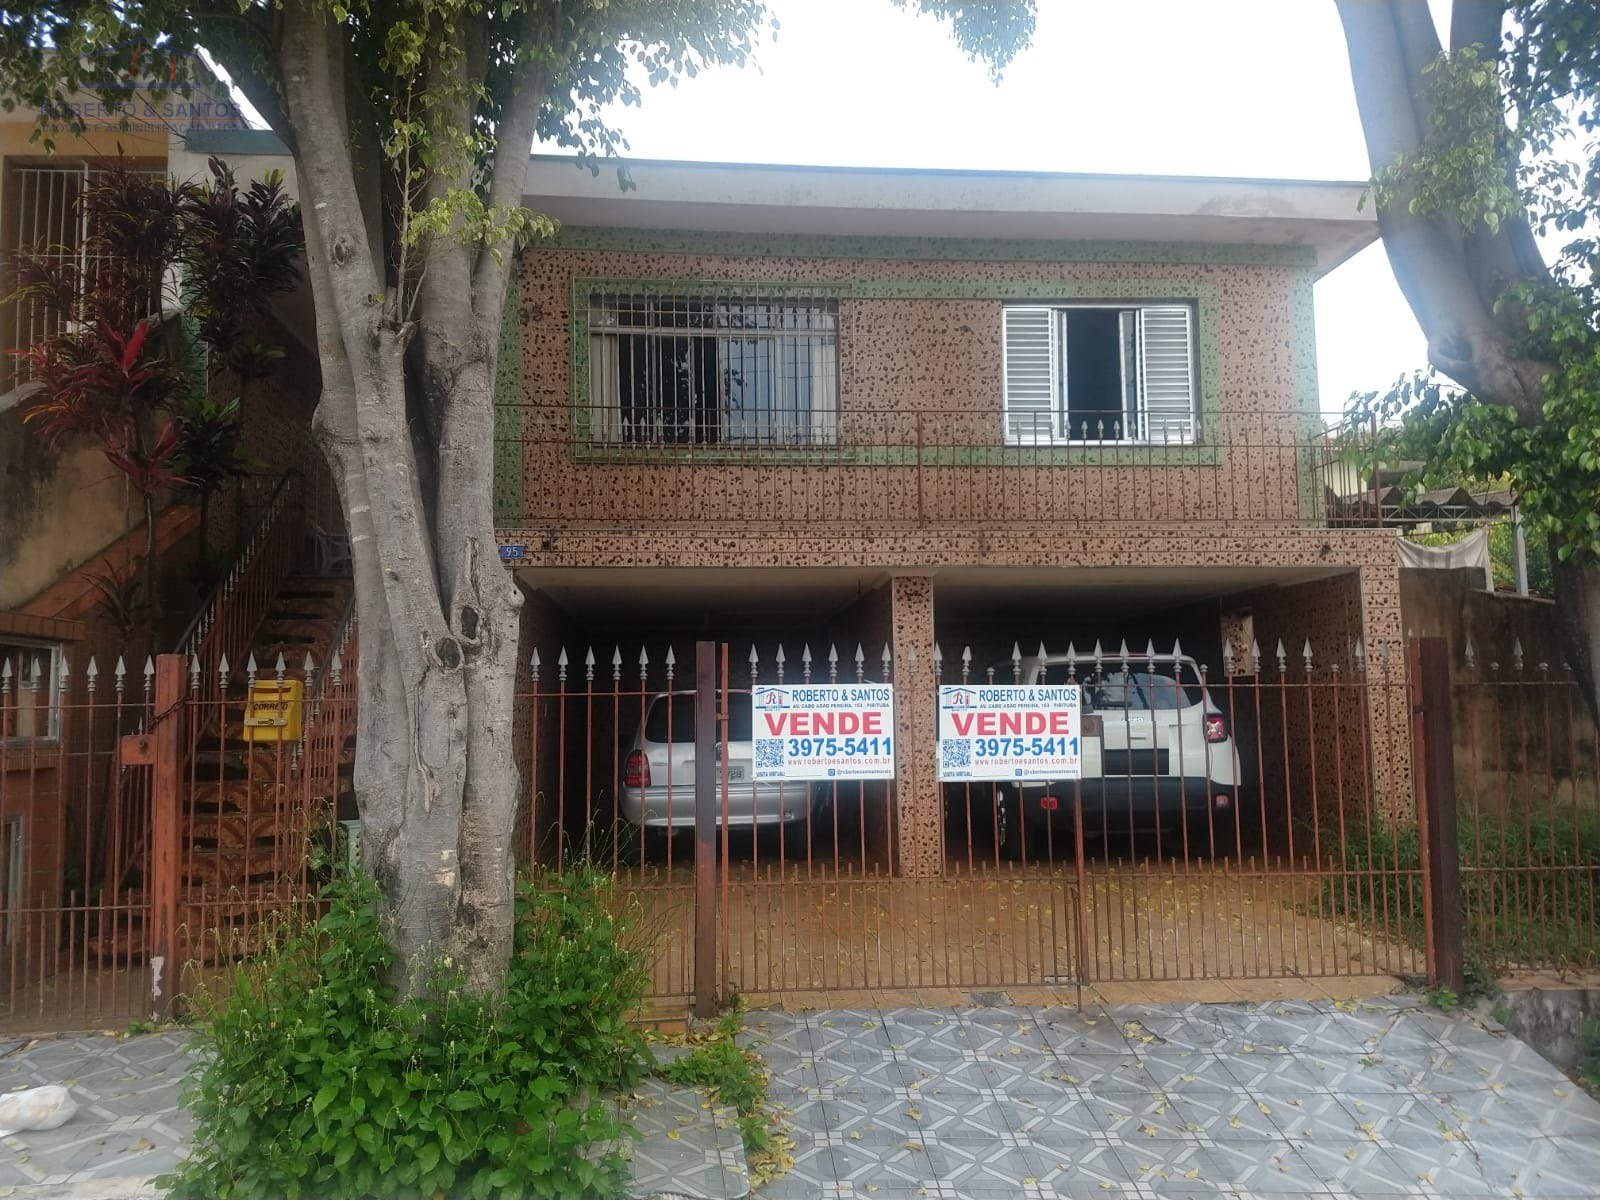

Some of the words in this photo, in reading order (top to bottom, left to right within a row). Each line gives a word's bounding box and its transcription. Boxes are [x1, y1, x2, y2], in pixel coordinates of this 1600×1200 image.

[506, 546, 519, 557] 95
[792, 689, 839, 702] ROBERTO
[841, 689, 848, 701] &
[851, 688, 890, 701] SANTOS
[979, 689, 1026, 702] ROBERTO
[1028, 689, 1035, 701] &
[1038, 688, 1077, 701] SANTOS
[254, 702, 289, 711] CORREO
[764, 712, 882, 736] VENDE
[951, 712, 1069, 736] VENDE
[788, 737, 891, 757] 3975-5411
[975, 737, 1078, 757] 3975-5411
[788, 757, 891, 766] www.robertoesantos.com.br
[975, 757, 1078, 766] www.robertoesantos.com.br
